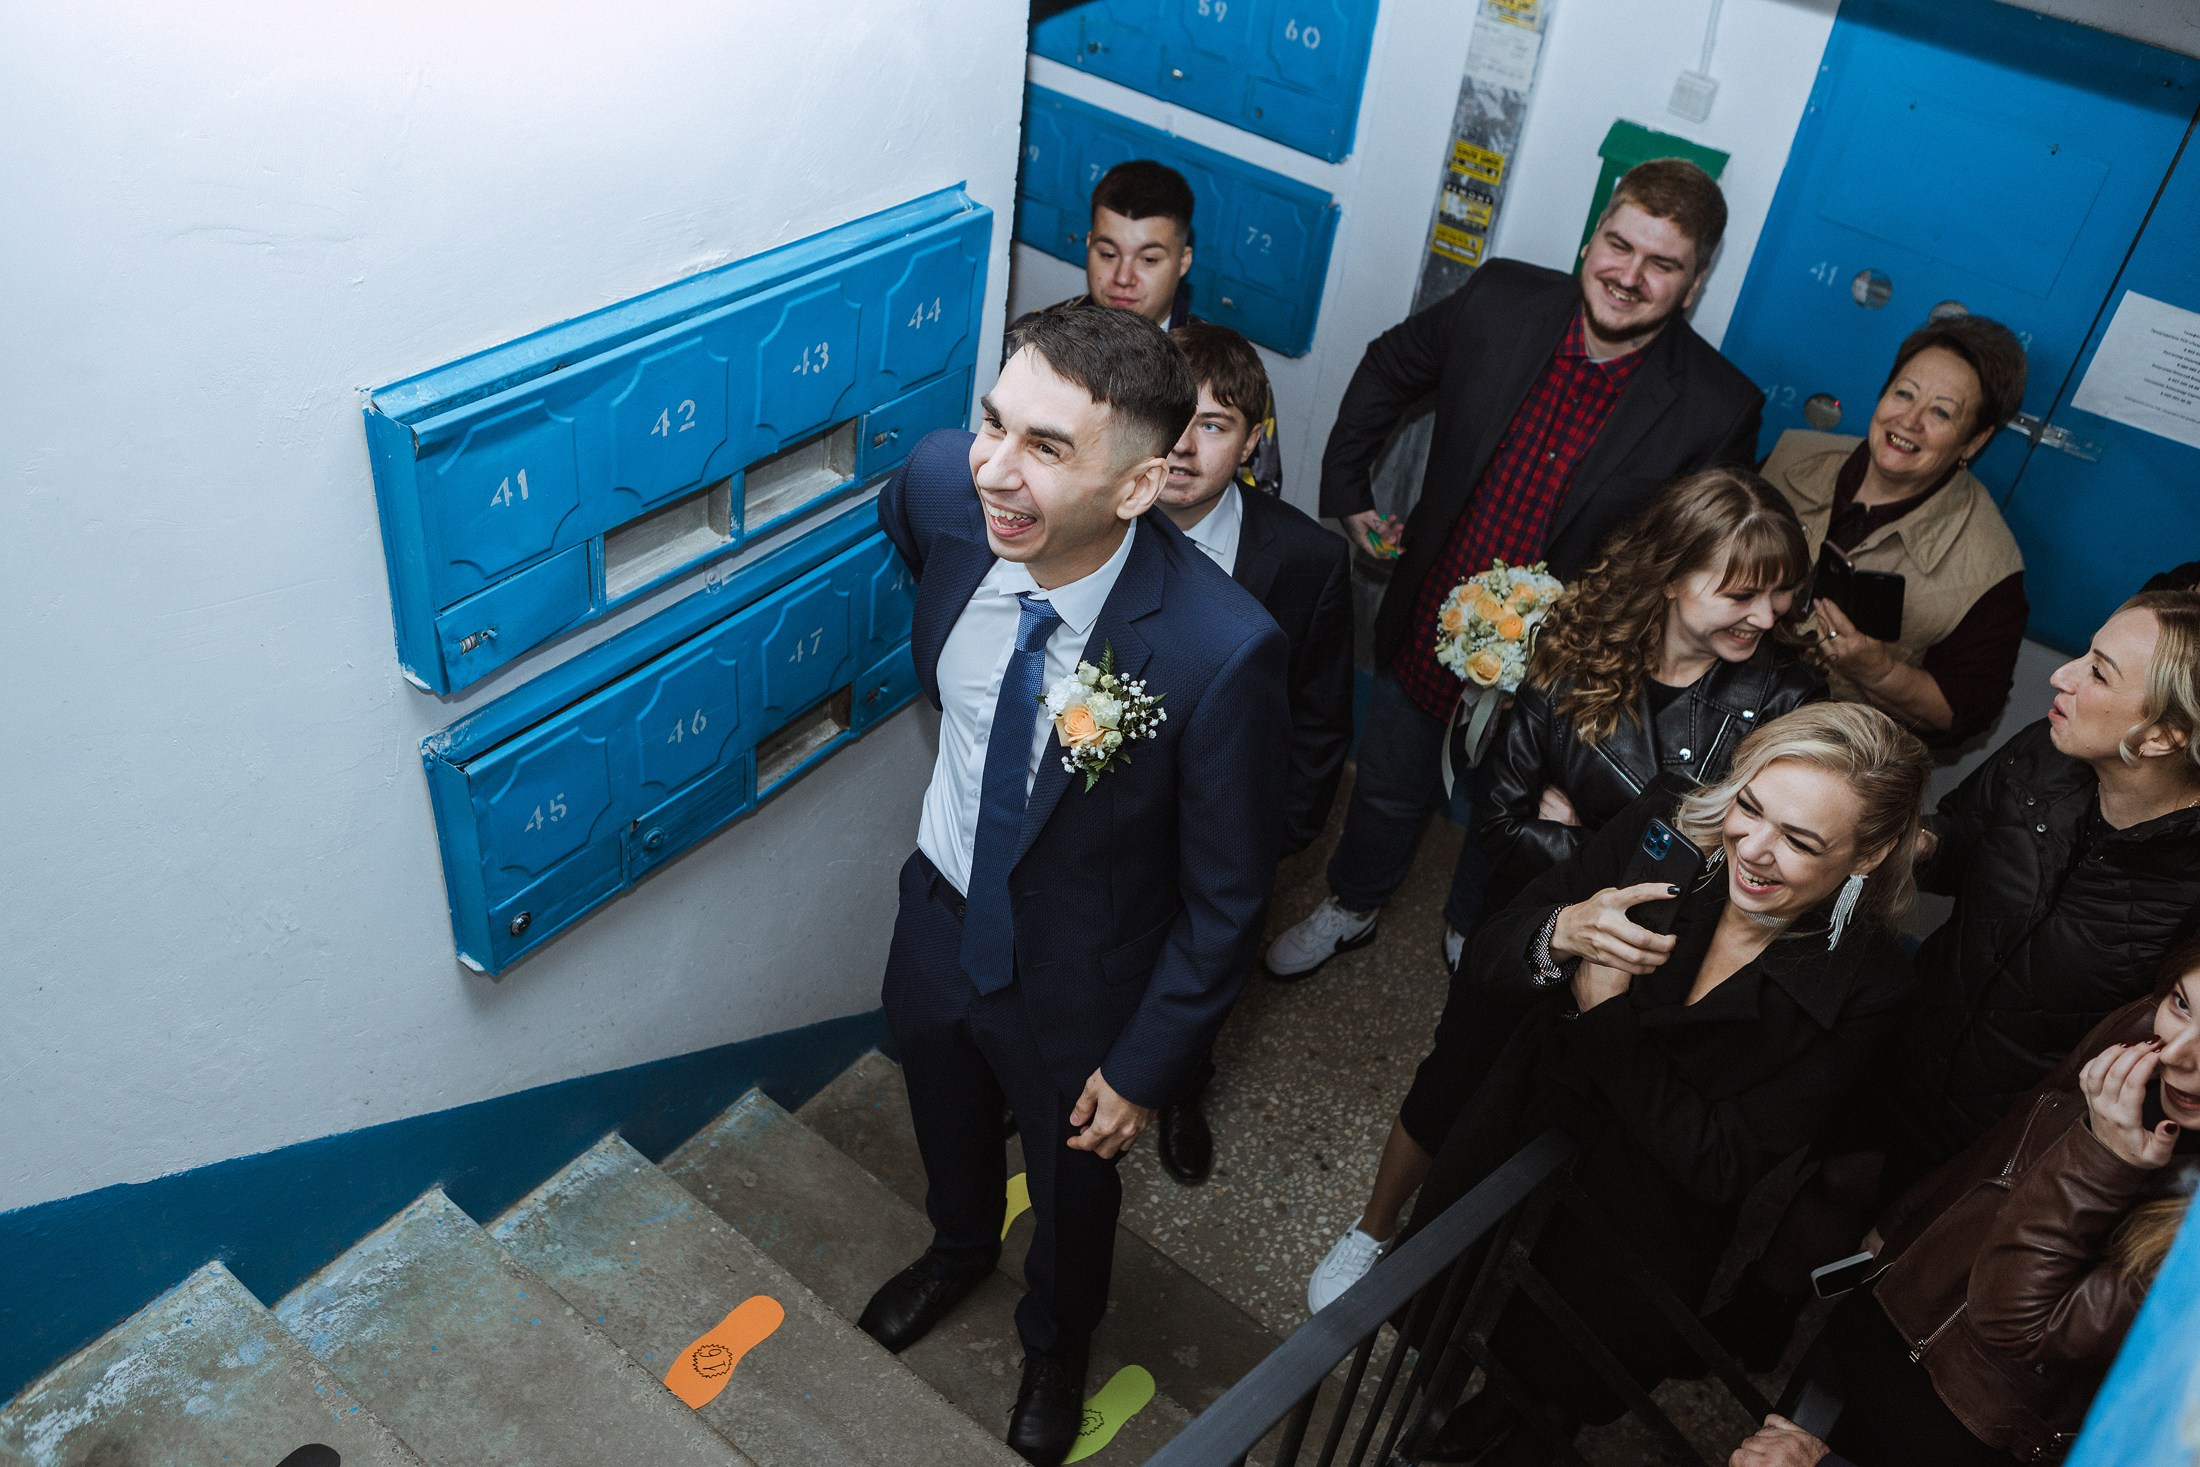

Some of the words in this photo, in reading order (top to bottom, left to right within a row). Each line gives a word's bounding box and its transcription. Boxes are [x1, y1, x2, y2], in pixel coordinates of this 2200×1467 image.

[1285, 18, 1321, 50] 60
[1246, 226, 1272, 254] 72
[1810, 261, 1838, 286] 41
[908, 297, 942, 330] 44
[793, 341, 829, 376] 43
[650, 399, 696, 438] 42
[490, 468, 530, 507] 41
[891, 569, 915, 591] 4
[788, 627, 824, 663] 47
[667, 708, 707, 745] 46
[524, 792, 568, 833] 45
